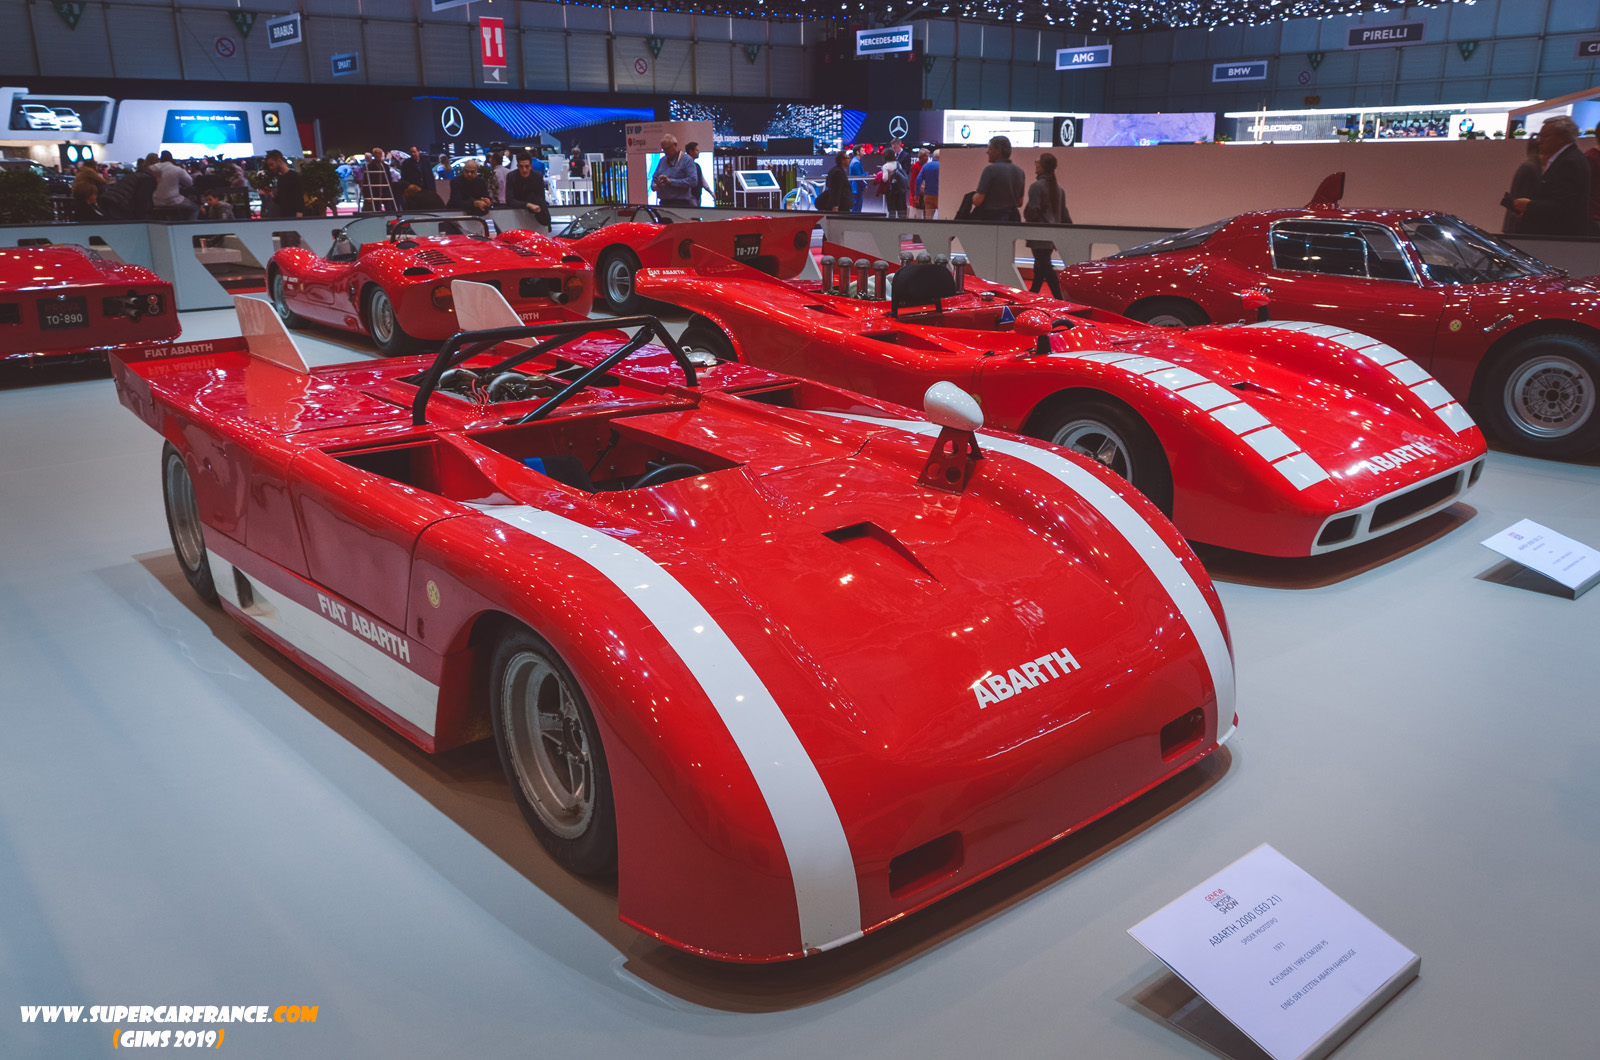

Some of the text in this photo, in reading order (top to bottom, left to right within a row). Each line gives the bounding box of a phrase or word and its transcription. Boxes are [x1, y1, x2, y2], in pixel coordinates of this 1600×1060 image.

[273, 24, 294, 38] BRABUS
[1362, 28, 1408, 41] PIRELLI
[859, 34, 909, 46] MERCEDES-BENZ
[337, 59, 351, 70] SMART
[1072, 52, 1095, 63] AMG
[1228, 67, 1251, 76] BMW
[752, 134, 762, 142] 450
[518, 312, 539, 321] ARTH
[144, 343, 214, 359] FIAT ABARTH
[1359, 441, 1437, 475] ABARTH
[317, 593, 411, 664] FIAT ABARTH
[972, 647, 1082, 710] ABARTH
[1205, 888, 1224, 902] GENEVA
[1213, 895, 1233, 909] MOTOR
[1220, 898, 1240, 914] SHOW
[1208, 924, 1239, 947] ABARTH
[1236, 912, 1256, 928] 2000
[1266, 894, 1282, 906] 21)
[1240, 918, 1278, 945] SPIDER PROTOTIPO
[1273, 942, 1286, 951] 1971
[1272, 966, 1294, 984] CYLINDER
[1280, 998, 1295, 1010] EINES
[1292, 992, 1302, 1001] DER
[1300, 978, 1320, 994] LETZTEN
